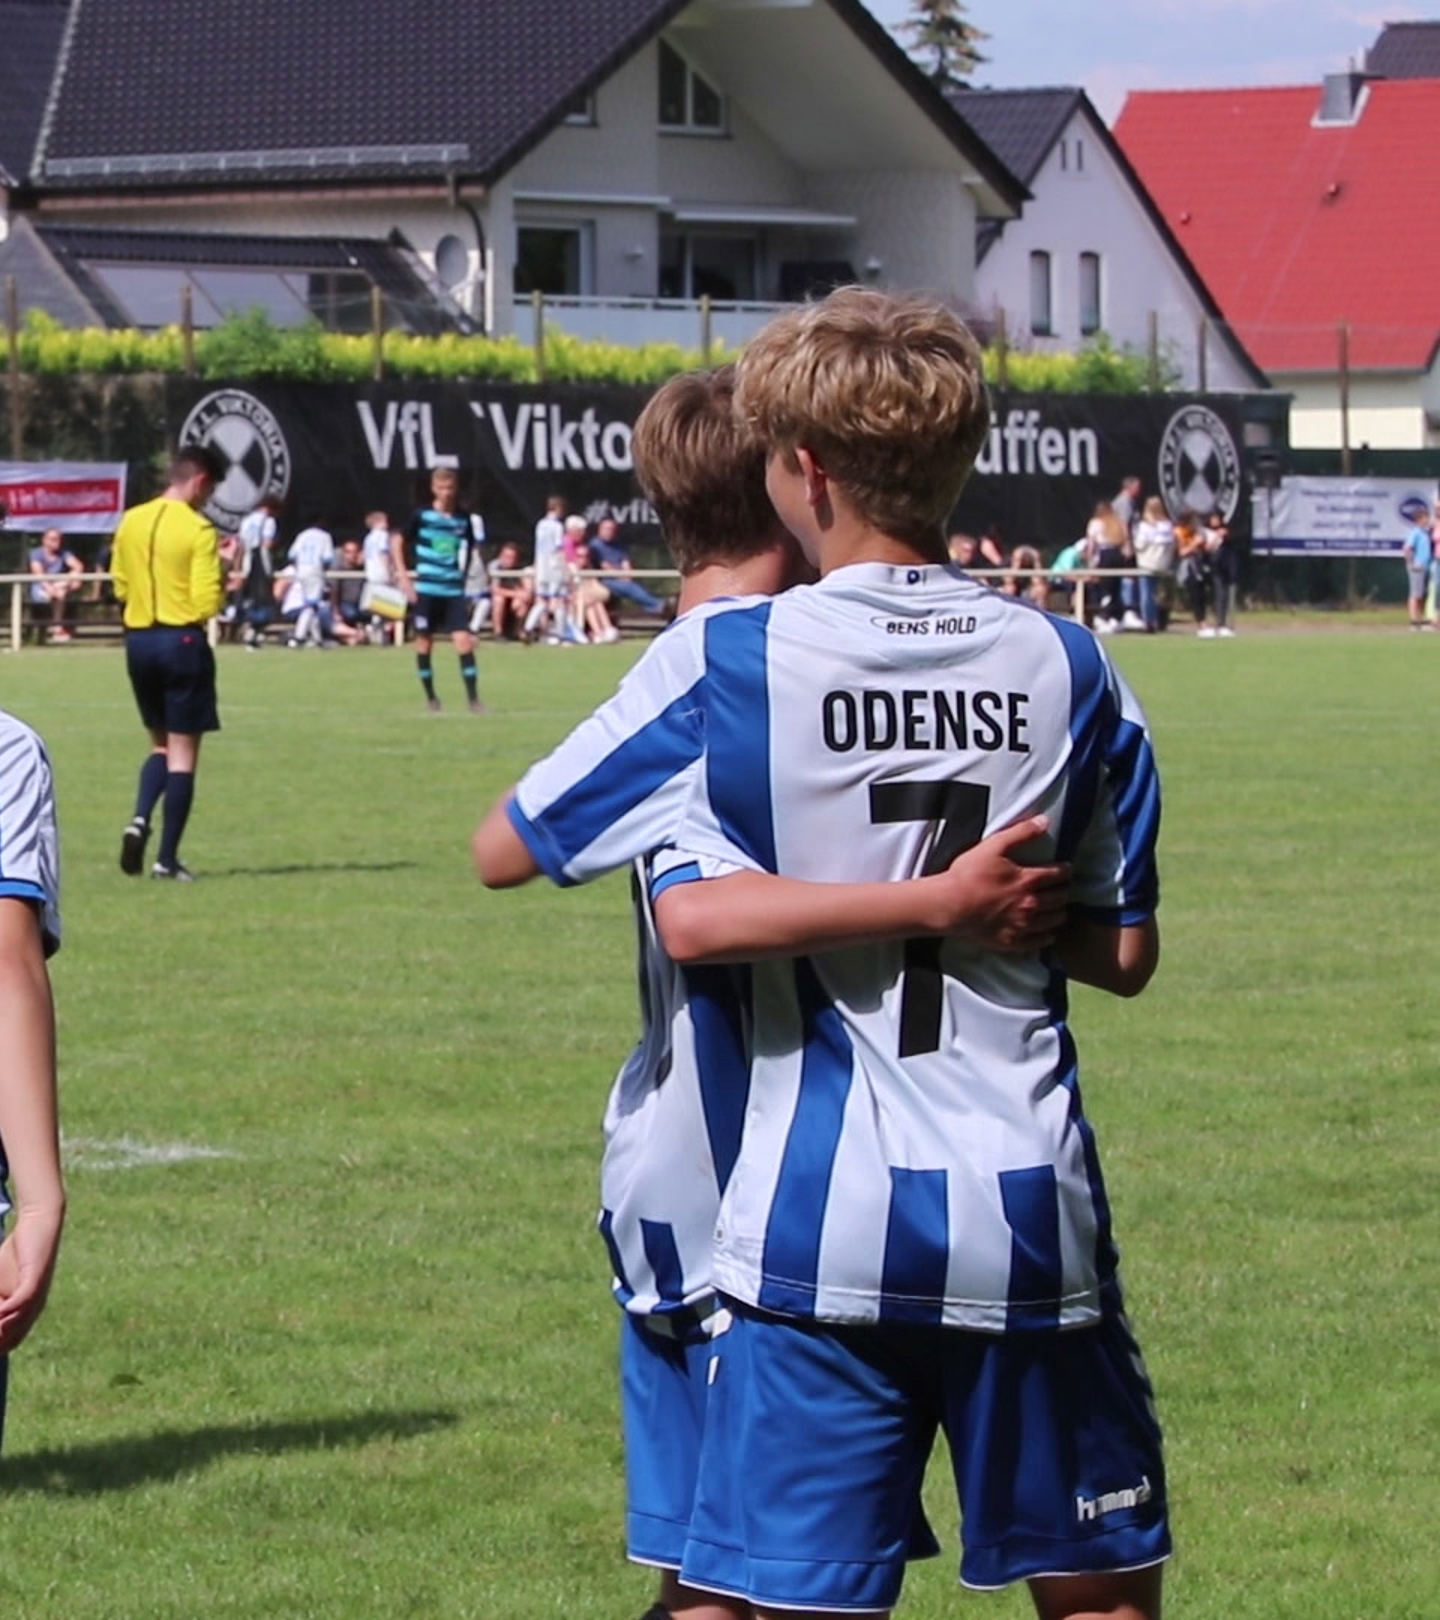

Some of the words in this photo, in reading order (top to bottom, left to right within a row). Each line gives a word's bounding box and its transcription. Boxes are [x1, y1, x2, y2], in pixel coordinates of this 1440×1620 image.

[357, 400, 459, 469] VfL
[469, 402, 634, 471] `Vikto
[974, 410, 1099, 476] üffen
[935, 616, 976, 635] HOLD
[823, 690, 1030, 752] ODENSE
[869, 780, 990, 1058] 7
